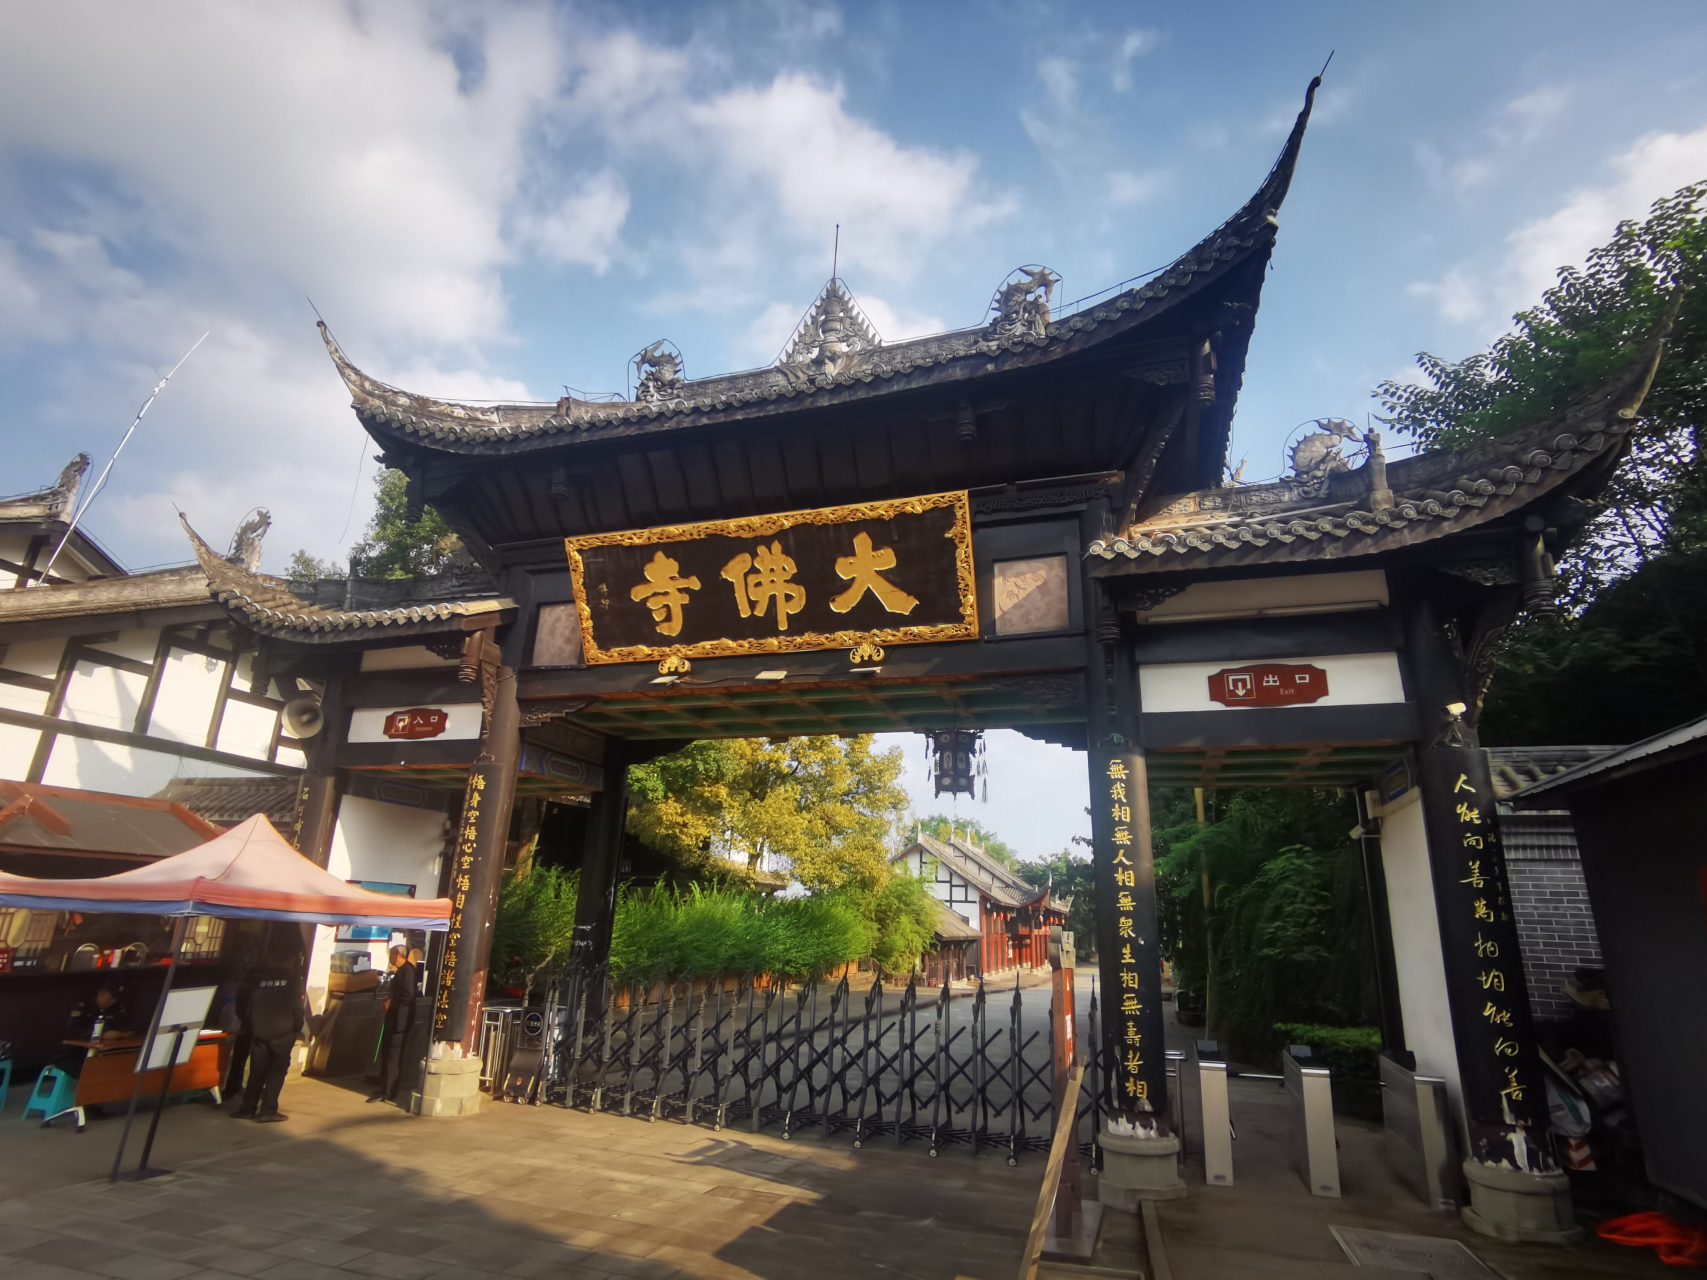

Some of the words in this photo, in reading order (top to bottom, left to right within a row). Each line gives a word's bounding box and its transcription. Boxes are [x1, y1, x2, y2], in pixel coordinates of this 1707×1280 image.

[630, 531, 920, 637] 大佛寺
[1262, 674, 1310, 686] 出口
[413, 715, 438, 724] 入口
